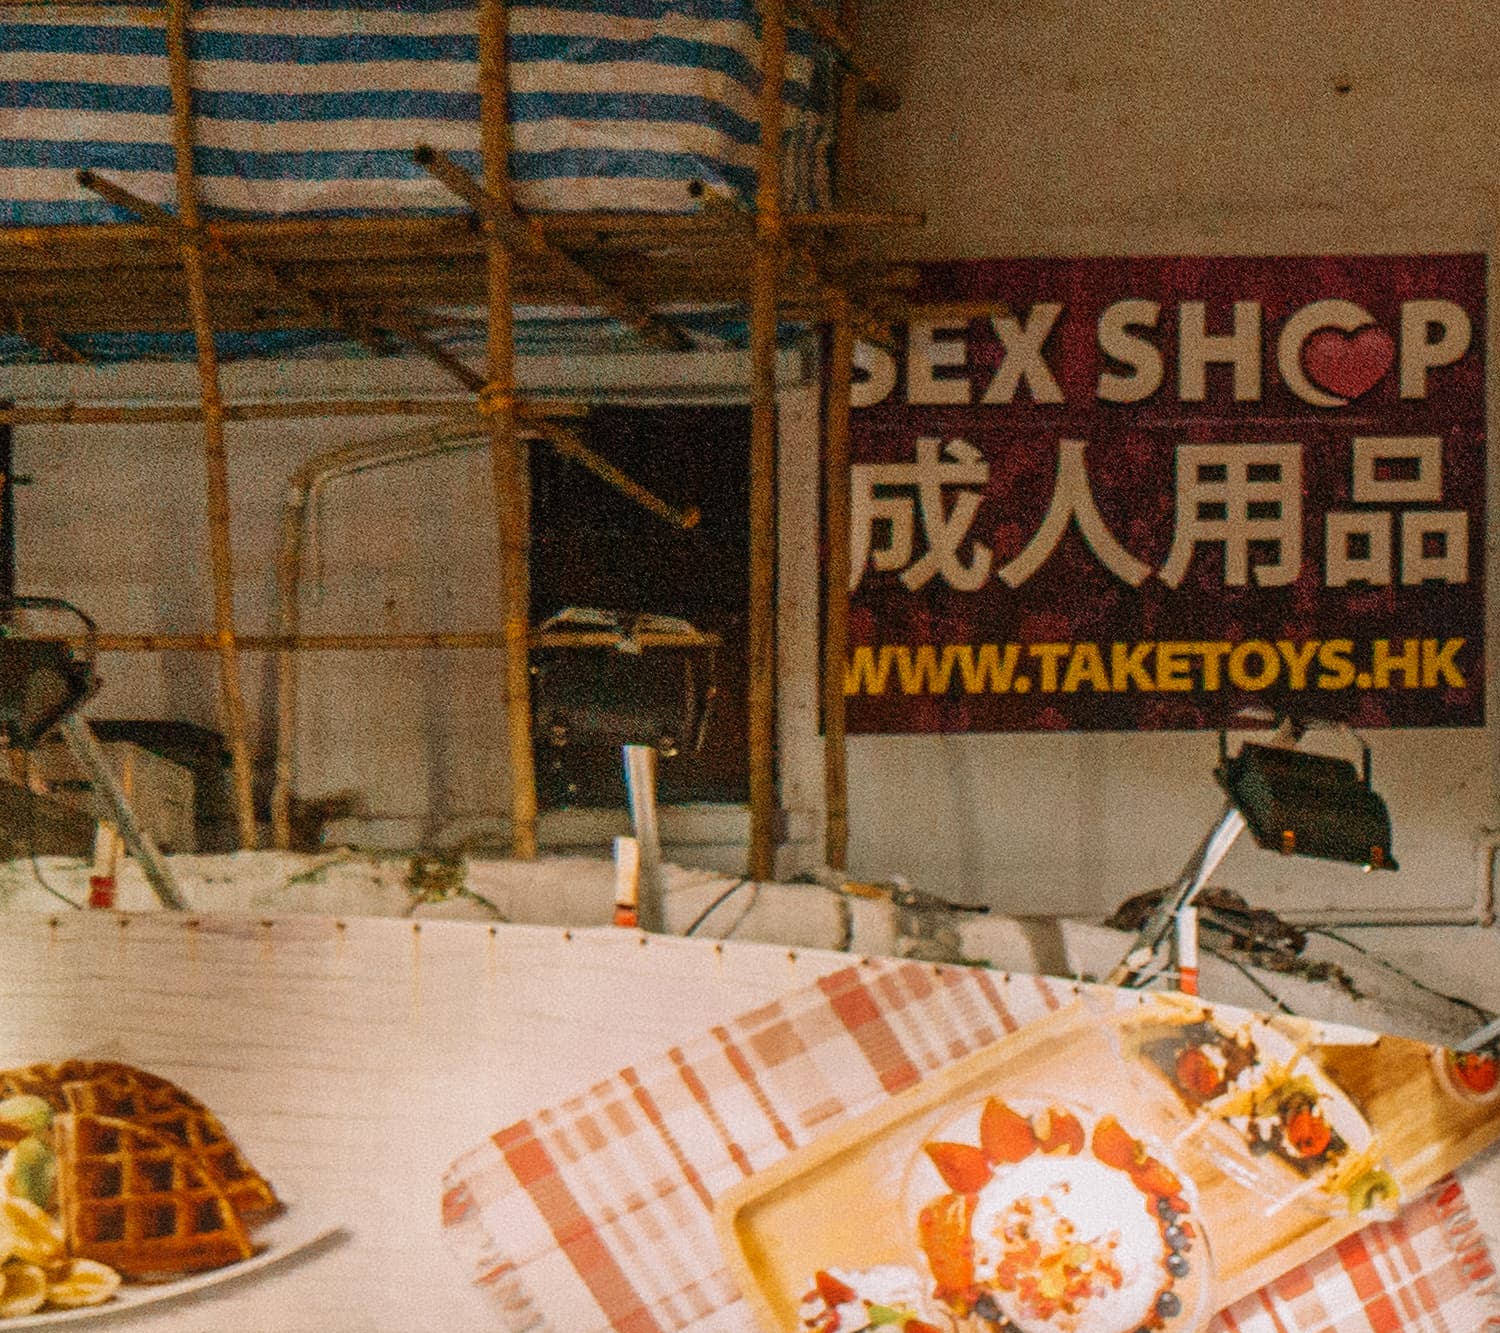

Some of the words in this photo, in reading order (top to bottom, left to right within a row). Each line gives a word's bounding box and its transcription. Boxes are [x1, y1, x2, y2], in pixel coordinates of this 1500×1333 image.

[850, 303, 1065, 407] SEX
[1098, 299, 1471, 407] SHOP
[848, 435, 1469, 592] 成人用品
[845, 637, 1467, 696] WWW.TAKETOYS.HK
